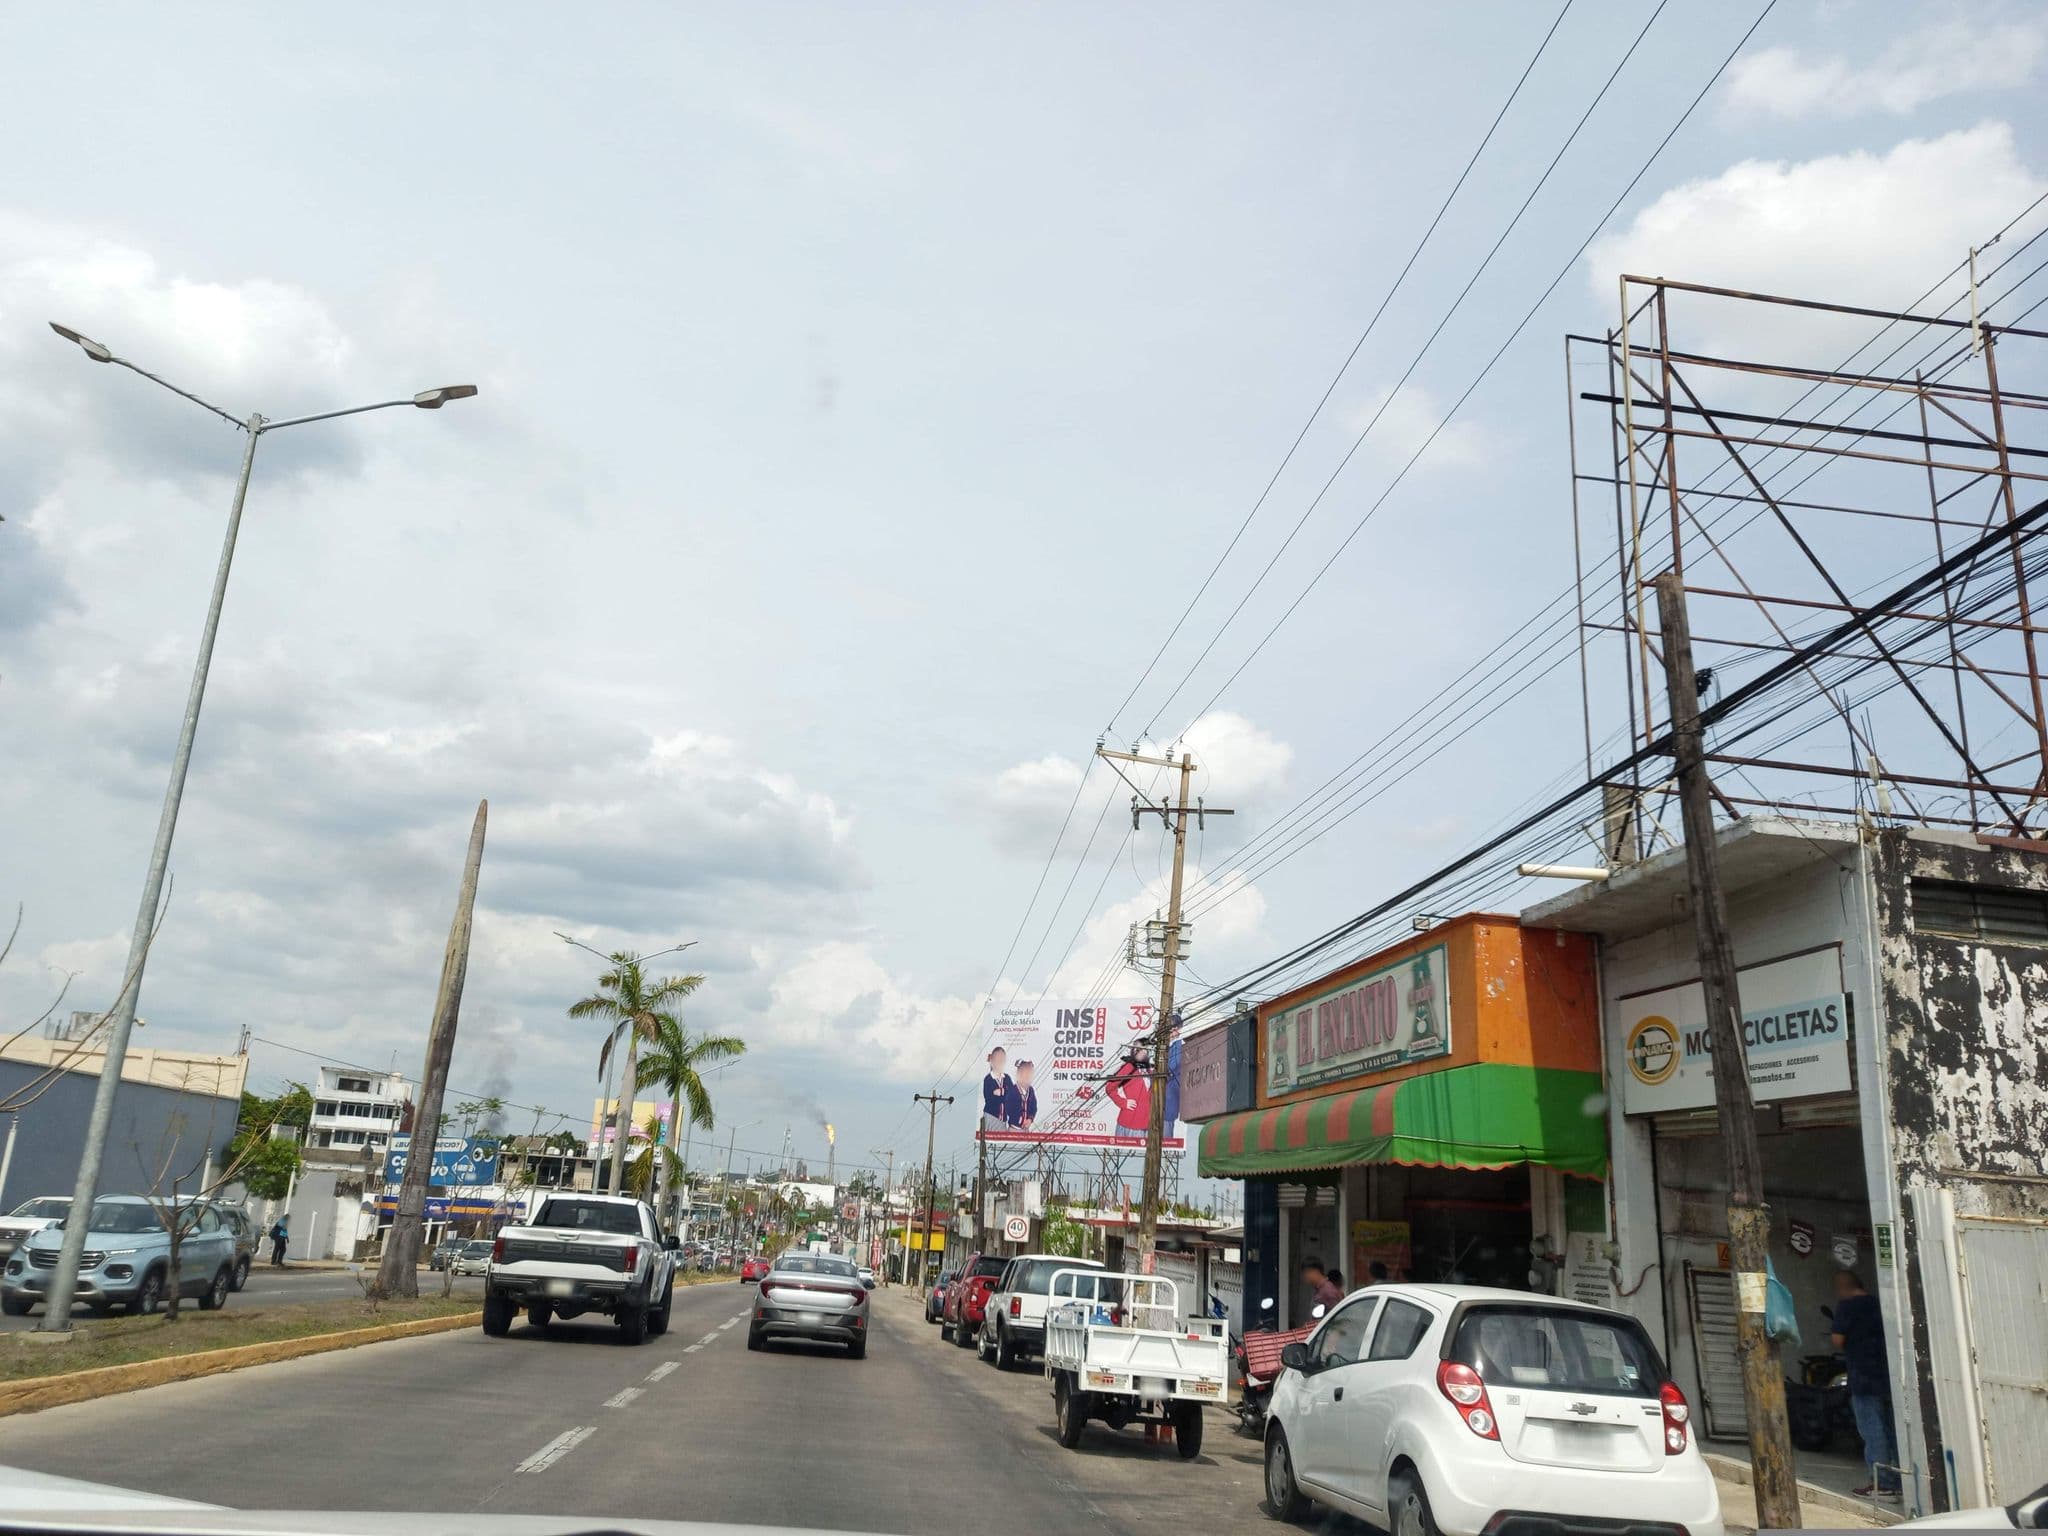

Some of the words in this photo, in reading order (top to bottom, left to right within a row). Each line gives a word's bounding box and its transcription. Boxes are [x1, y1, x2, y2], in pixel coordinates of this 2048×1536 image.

[1056, 1008, 1094, 1028] INS
[1297, 1011, 1316, 1066] EL
[1319, 975, 1398, 1061] ENCANTO
[1096, 1008, 1106, 1043] 2024
[1054, 1030, 1093, 1044] CRIP
[1053, 1046, 1104, 1058] CIONES
[1053, 1060, 1104, 1069] ABIERTAS
[1053, 1072, 1069, 1081] SIN
[1070, 1072, 1101, 1081] COSTO
[1085, 1123, 1096, 1131] 23
[1098, 1123, 1107, 1132] 01
[1010, 1221, 1023, 1231] 40
[507, 1241, 622, 1258] FORD
